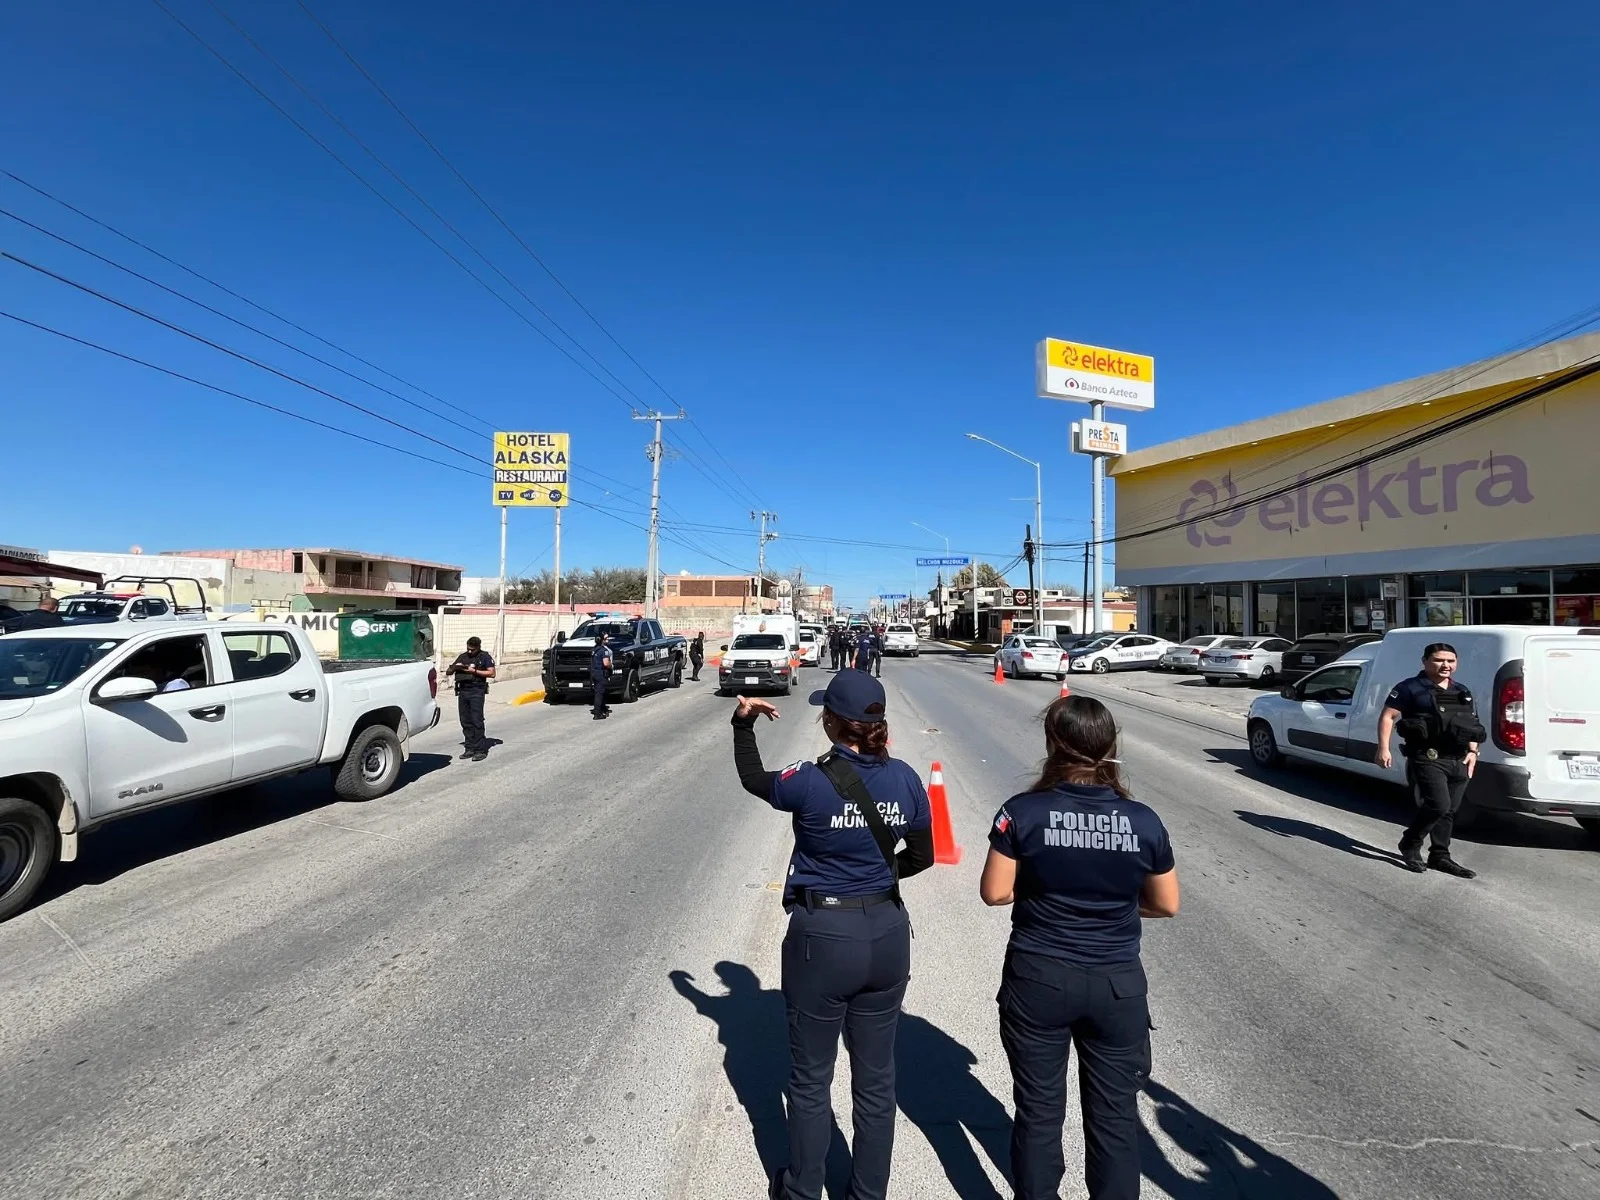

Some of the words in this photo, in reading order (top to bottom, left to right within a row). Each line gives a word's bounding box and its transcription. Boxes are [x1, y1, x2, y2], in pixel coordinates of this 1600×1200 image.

[1082, 351, 1139, 377] elektra
[1081, 382, 1108, 394] Banco
[1109, 387, 1138, 399] Azteca
[507, 434, 556, 447] HOTEL
[495, 451, 566, 464] ALASKA
[496, 470, 565, 482] RESTAURANT
[1258, 454, 1534, 532] elektra
[118, 783, 164, 799] RAM
[1049, 810, 1133, 834] POLICÍA
[1044, 828, 1141, 852] MUNICIPAL
